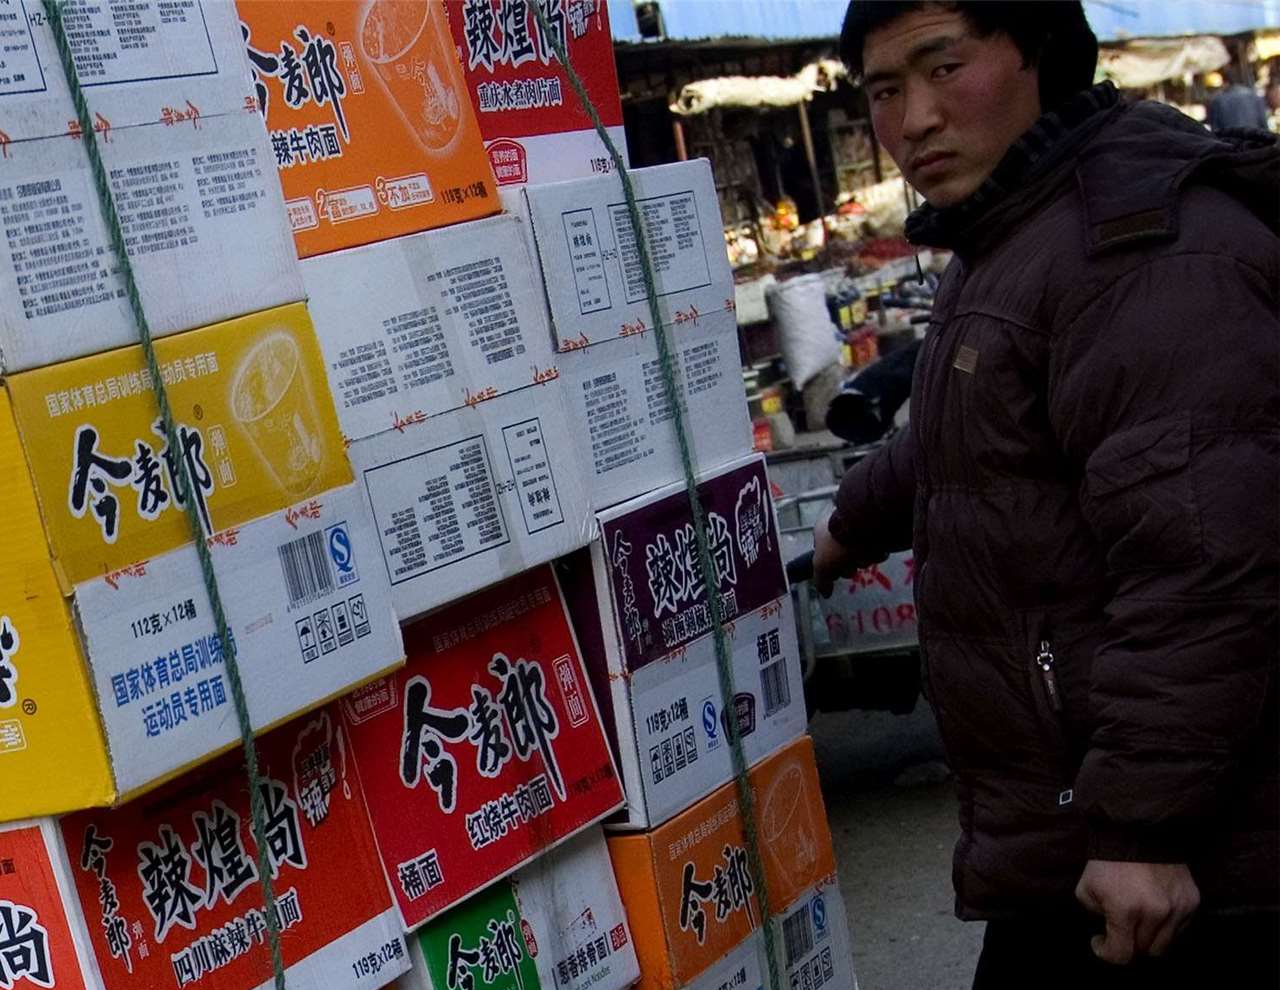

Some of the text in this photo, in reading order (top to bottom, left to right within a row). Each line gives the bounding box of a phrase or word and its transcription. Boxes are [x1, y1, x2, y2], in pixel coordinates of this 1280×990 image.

[45, 351, 219, 417] 国家体育总局训练局动员专用面
[69, 423, 213, 544] 今麦郎
[757, 628, 781, 665] 桶面
[141, 674, 227, 737] 运动员专用面
[400, 652, 566, 813] 今麦郎
[464, 772, 554, 850] 红烧牛肉面
[80, 824, 133, 973] 今麦郎
[136, 777, 308, 942] 辣煌尚
[397, 849, 444, 900] 桶面
[680, 843, 754, 946] 今麦郎
